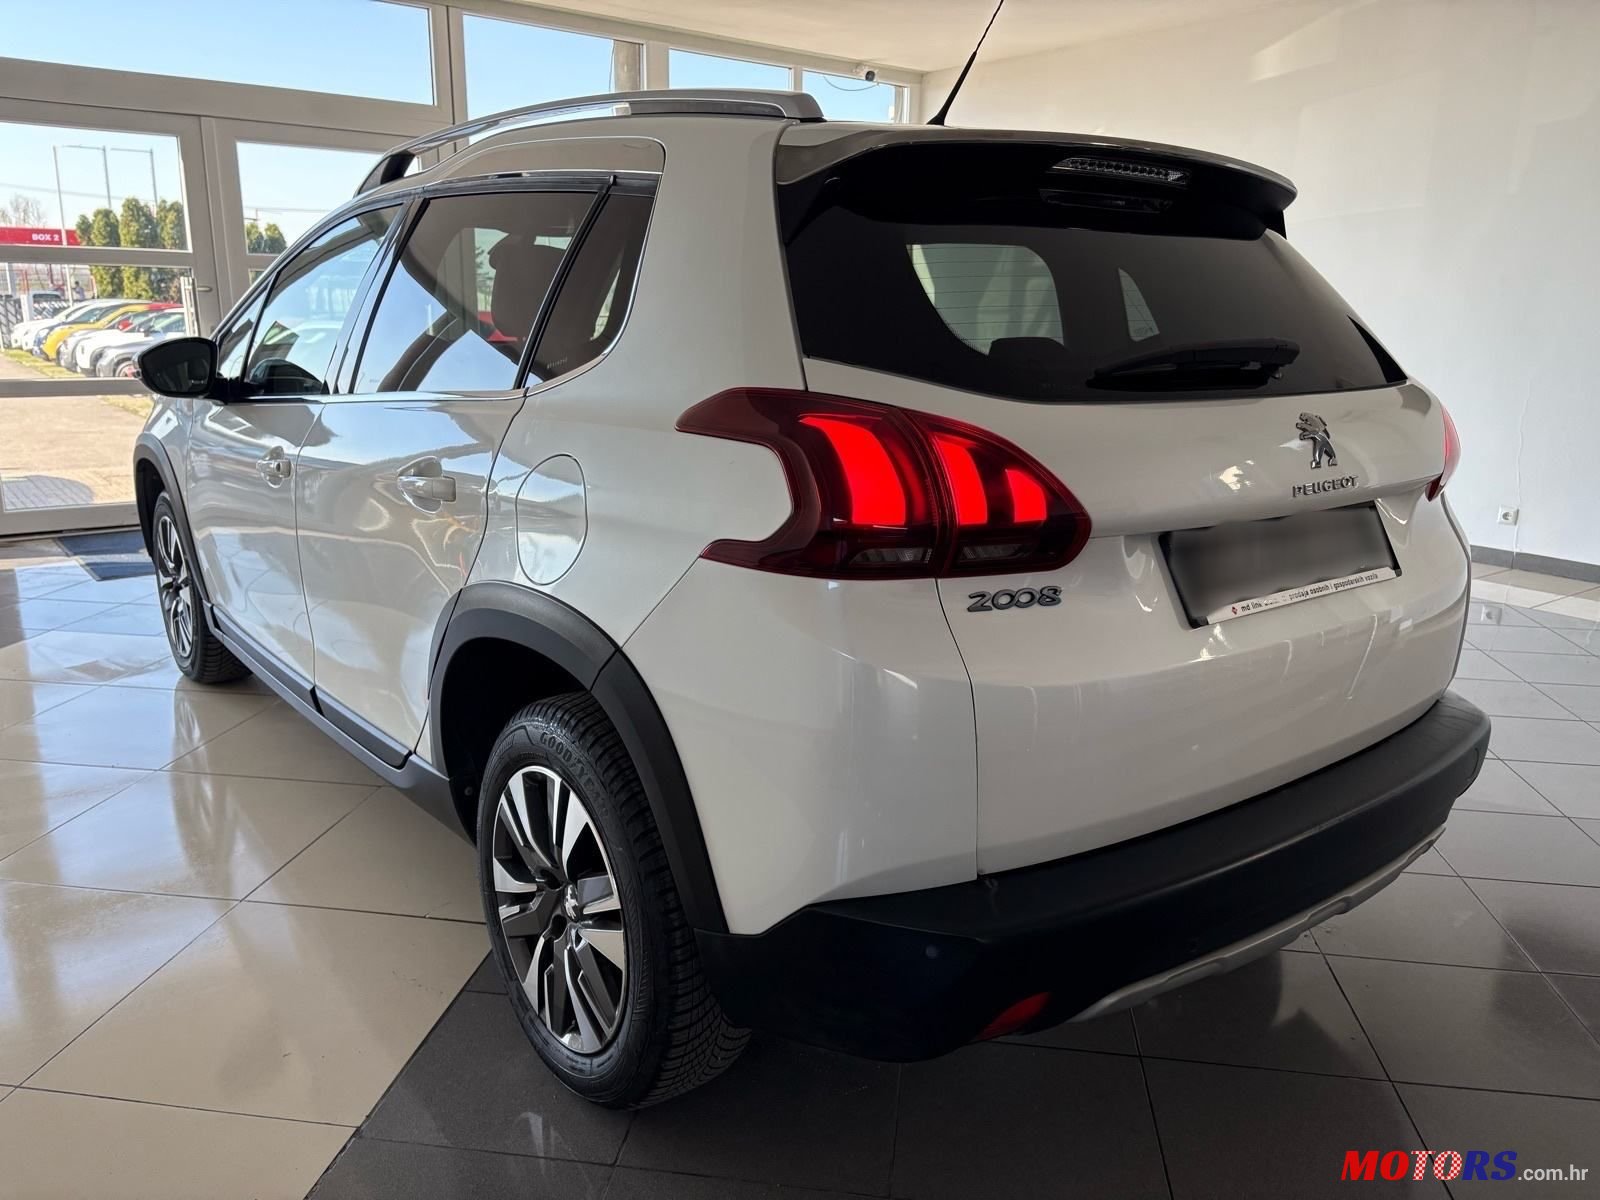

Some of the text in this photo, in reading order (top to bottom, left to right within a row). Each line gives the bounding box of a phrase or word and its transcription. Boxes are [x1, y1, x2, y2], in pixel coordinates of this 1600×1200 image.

[31, 233, 51, 241] BOX
[1292, 475, 1359, 498] PEUGEOT
[1310, 584, 1329, 594] osobnih
[1334, 577, 1364, 590] gospodarskih
[1365, 573, 1378, 582] vozila
[966, 585, 1063, 613] 2008
